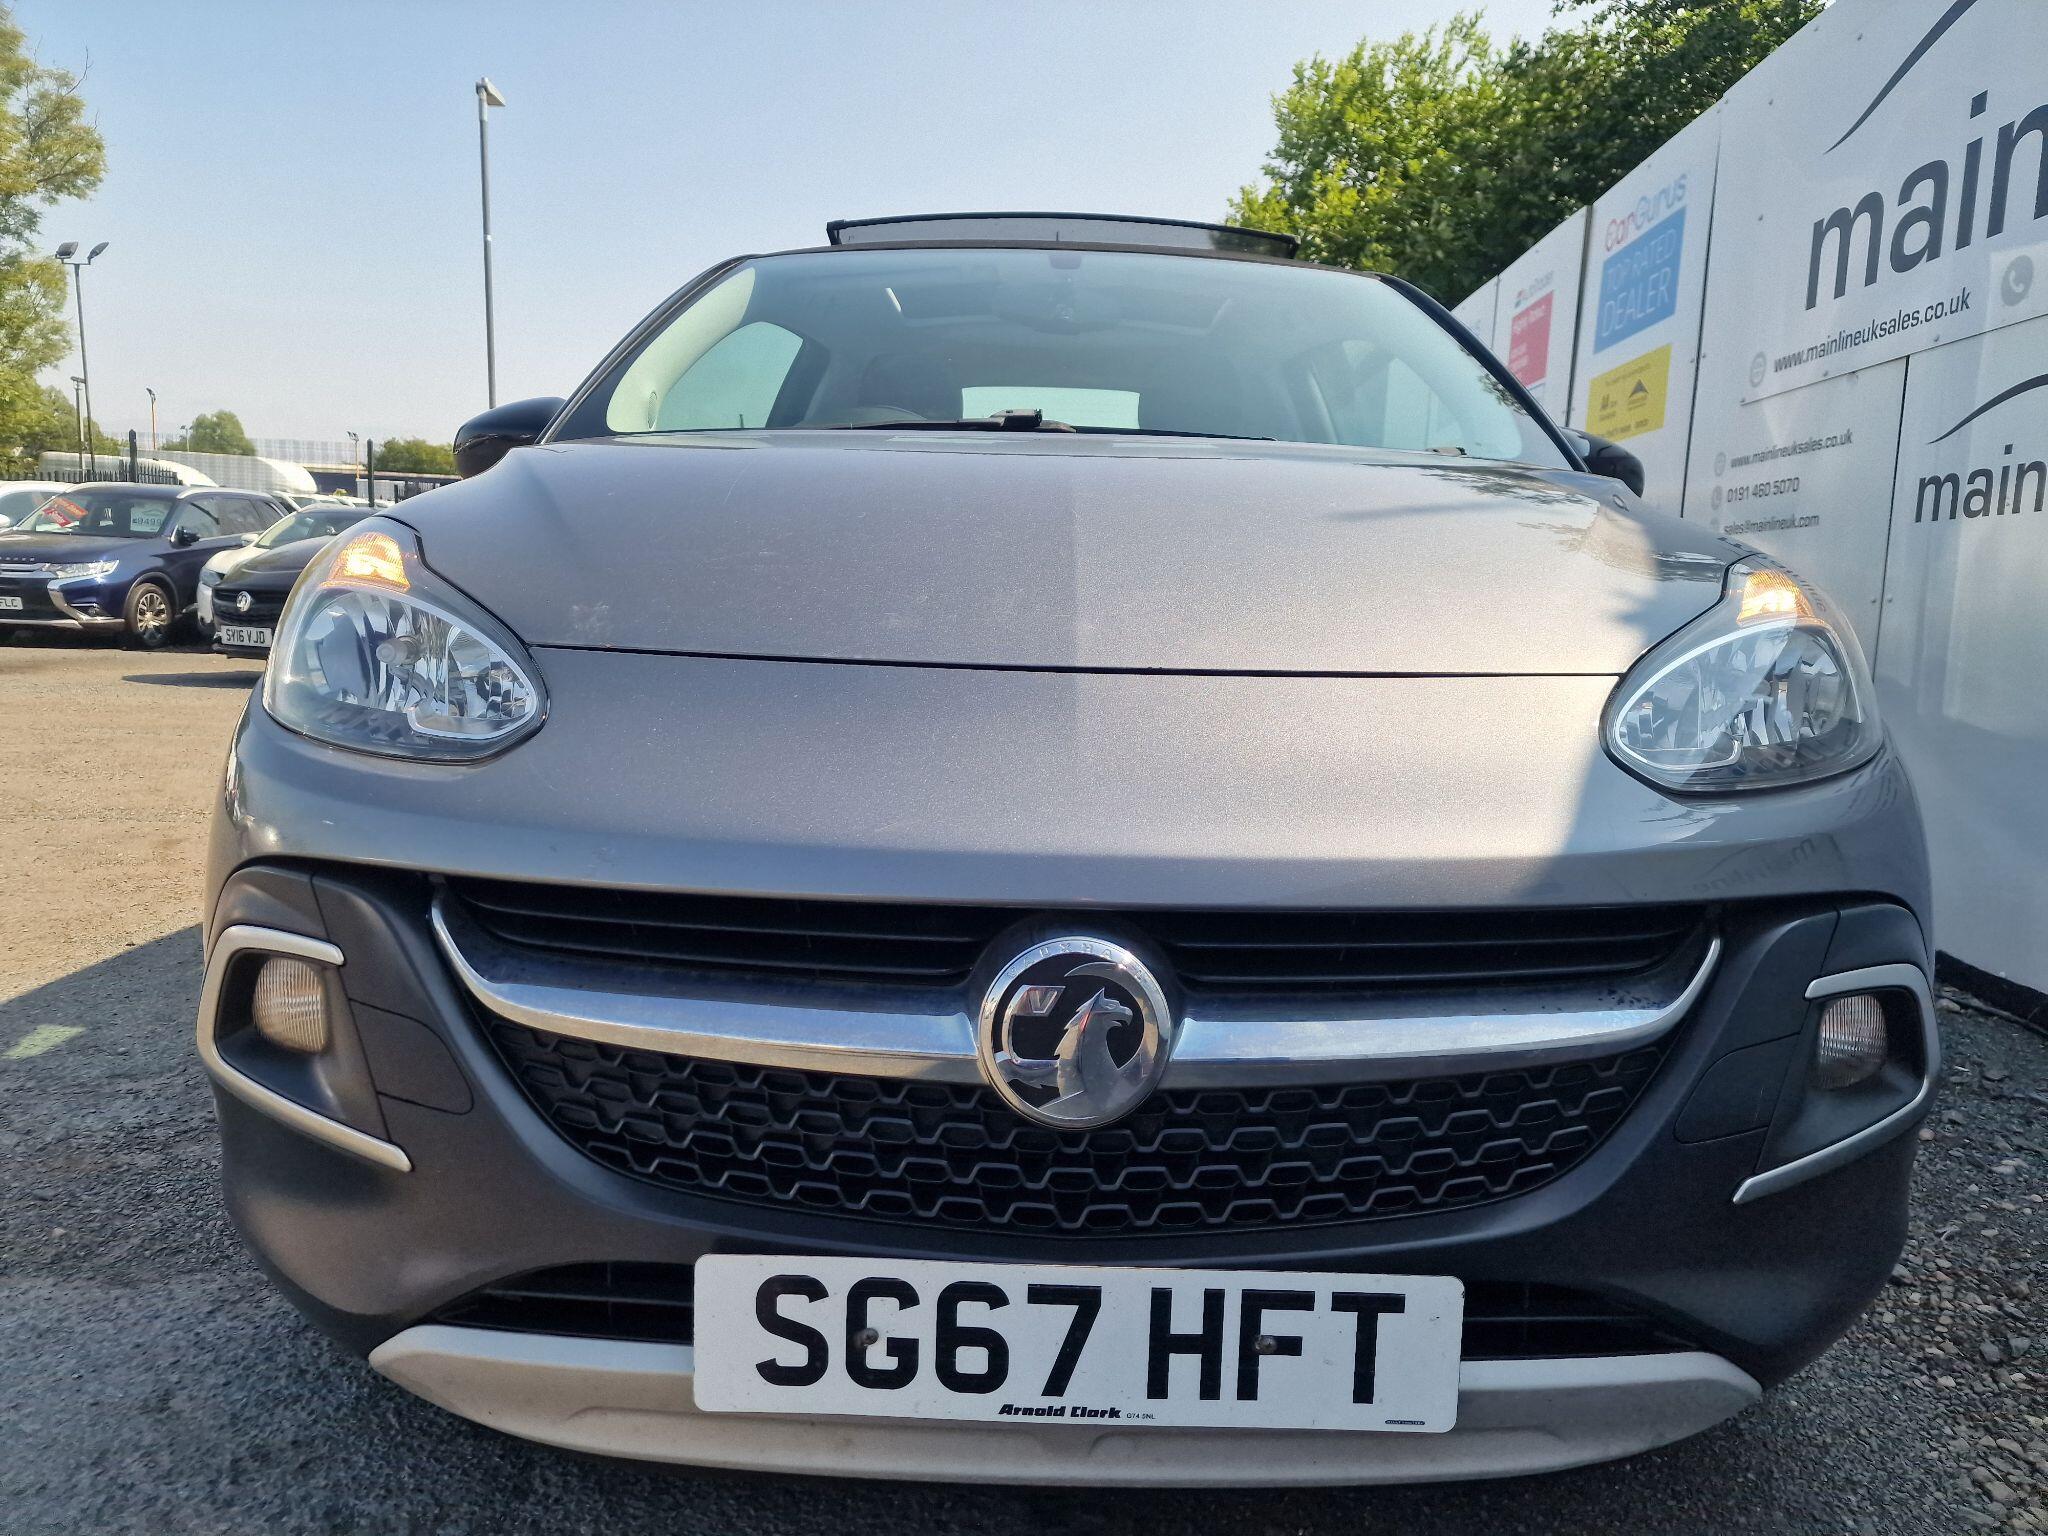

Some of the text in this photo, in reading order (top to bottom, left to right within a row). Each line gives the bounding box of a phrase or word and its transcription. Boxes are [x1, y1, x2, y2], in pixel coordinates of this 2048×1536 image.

[1601, 266, 1672, 337] DEALER
[1773, 286, 1971, 373] www.mainlineuksales.co.uk
[1730, 428, 1853, 469] www.mainlineuksales.co.uk
[1727, 476, 1800, 503] 0191 460 5070
[1914, 443, 2048, 523] main
[225, 629, 266, 644] SY16 VJD
[755, 1273, 1406, 1405] SG67 HFT
[998, 1403, 1066, 1417] Arnold
[1070, 1406, 1121, 1419] Clark
